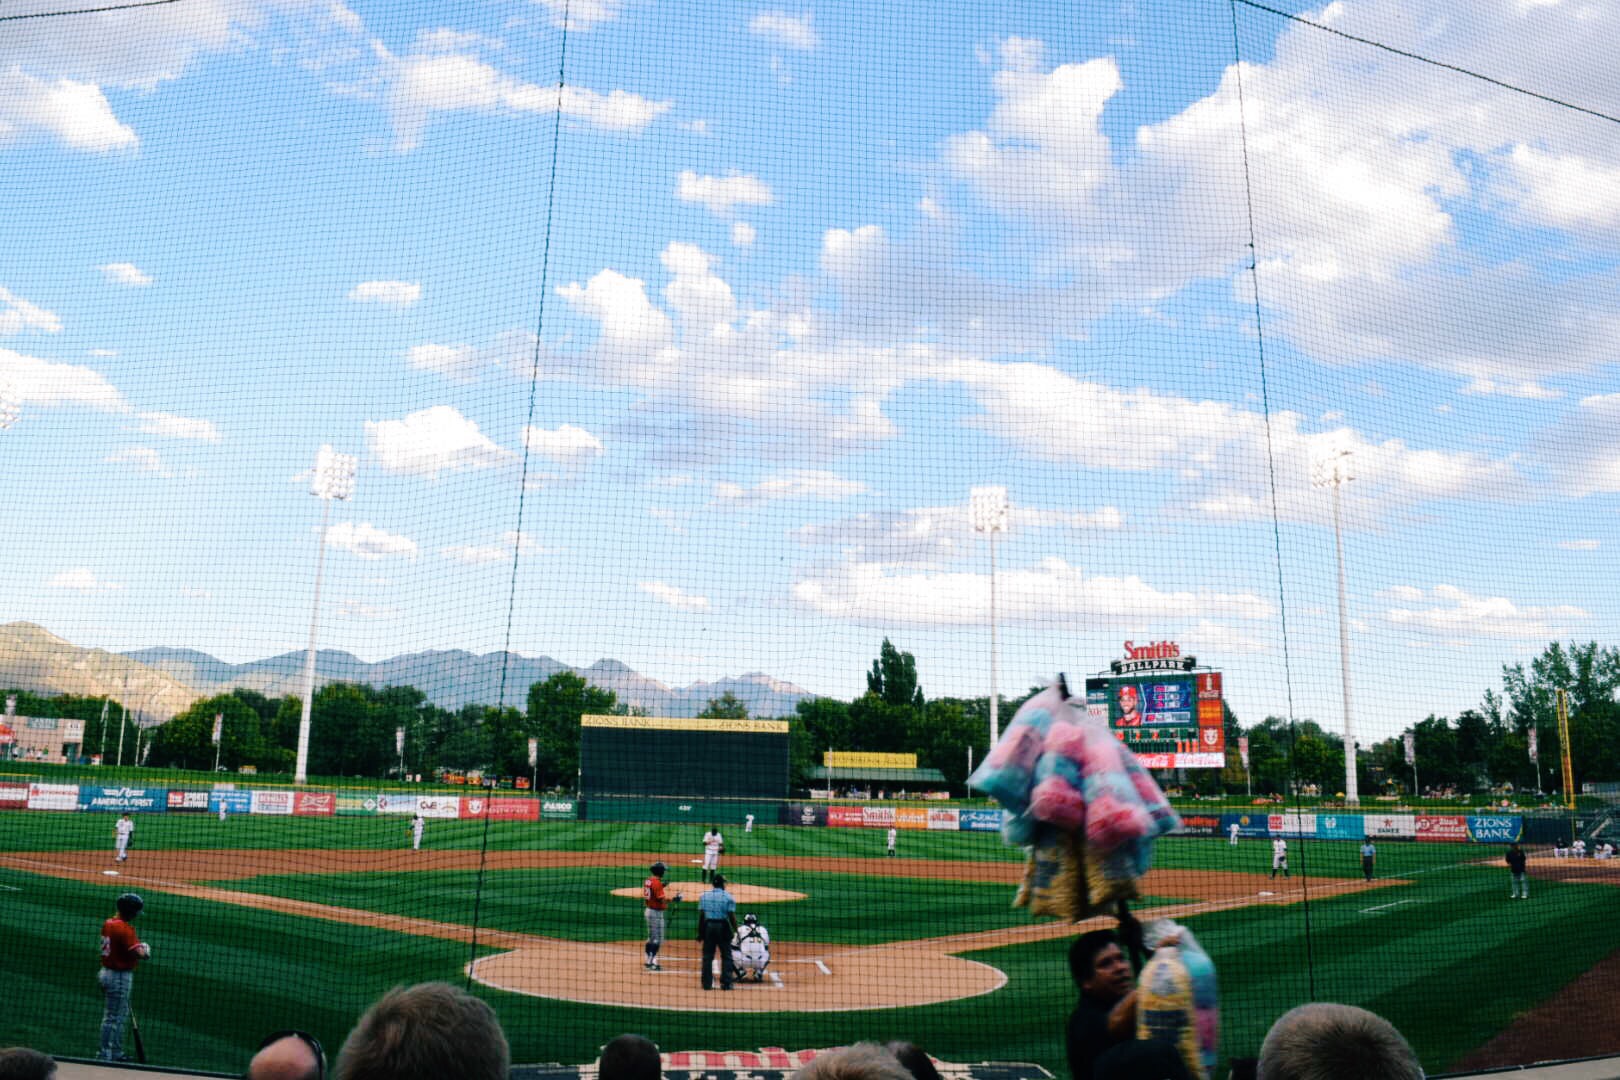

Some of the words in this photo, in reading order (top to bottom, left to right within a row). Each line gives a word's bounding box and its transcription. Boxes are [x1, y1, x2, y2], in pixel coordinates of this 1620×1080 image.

[1123, 640, 1180, 660] Smith's
[1121, 661, 1185, 672] BALLPARK
[585, 716, 619, 726] ZIONS
[621, 718, 650, 727] BANK
[718, 720, 749, 730] ZIONS
[754, 722, 784, 731] BANK
[91, 798, 129, 806] AMERICA
[130, 799, 154, 807] FIRST
[1474, 818, 1513, 828] ZIONS
[1475, 828, 1512, 839] BANK
